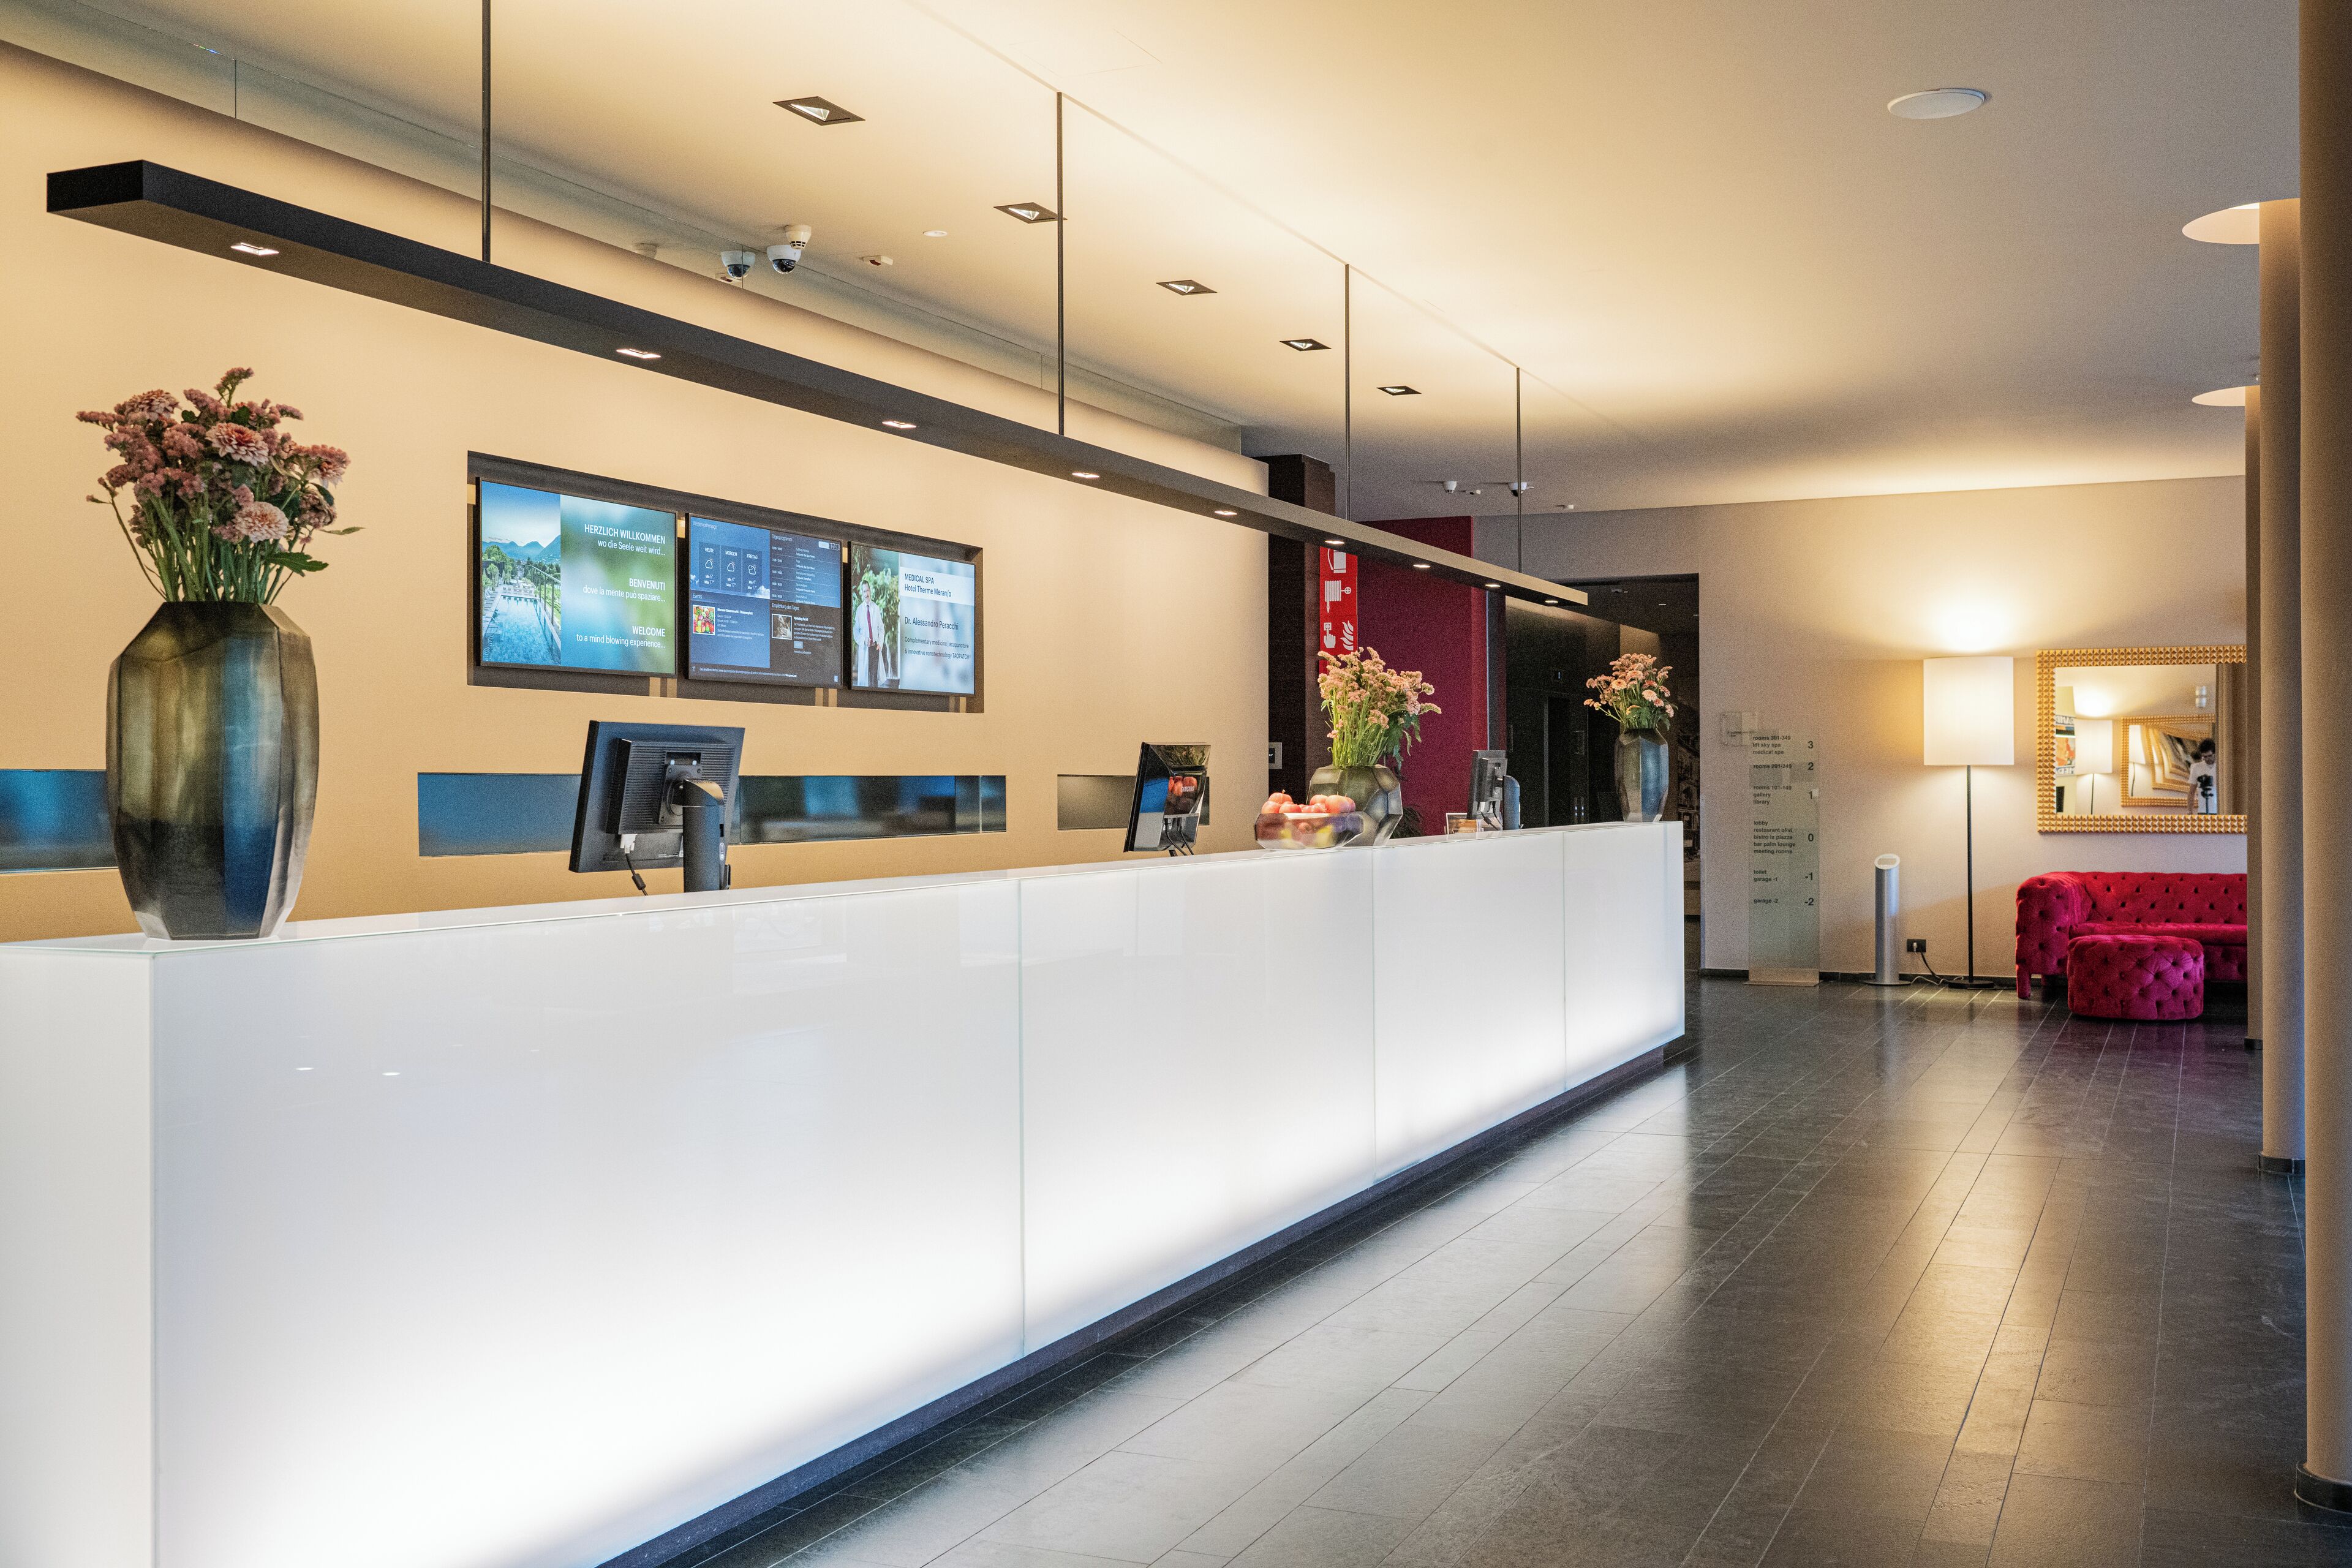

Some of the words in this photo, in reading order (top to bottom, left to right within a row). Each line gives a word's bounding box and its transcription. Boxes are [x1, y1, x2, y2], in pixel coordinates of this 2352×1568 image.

[584, 524, 619, 537] HERZLICH
[620, 529, 665, 545] WILLKOMMEN
[608, 540, 617, 549] die
[619, 541, 634, 551] Seele
[649, 547, 665, 556] wird...
[629, 578, 665, 590] BENVENUTI
[905, 573, 924, 583] MEDICAL
[583, 585, 598, 594] dove
[599, 586, 604, 595] la
[638, 593, 665, 602] spaziare...
[918, 586, 933, 595] Therme
[934, 588, 951, 598] Meran/o
[913, 617, 938, 628] Alessandro
[940, 621, 959, 630] Peracchi
[632, 625, 665, 637] WELCOME
[589, 635, 604, 643] mind
[606, 635, 628, 647] blowing
[630, 639, 665, 649] experience...
[905, 636, 932, 646] Complementary
[1805, 872, 1813, 881] -1
